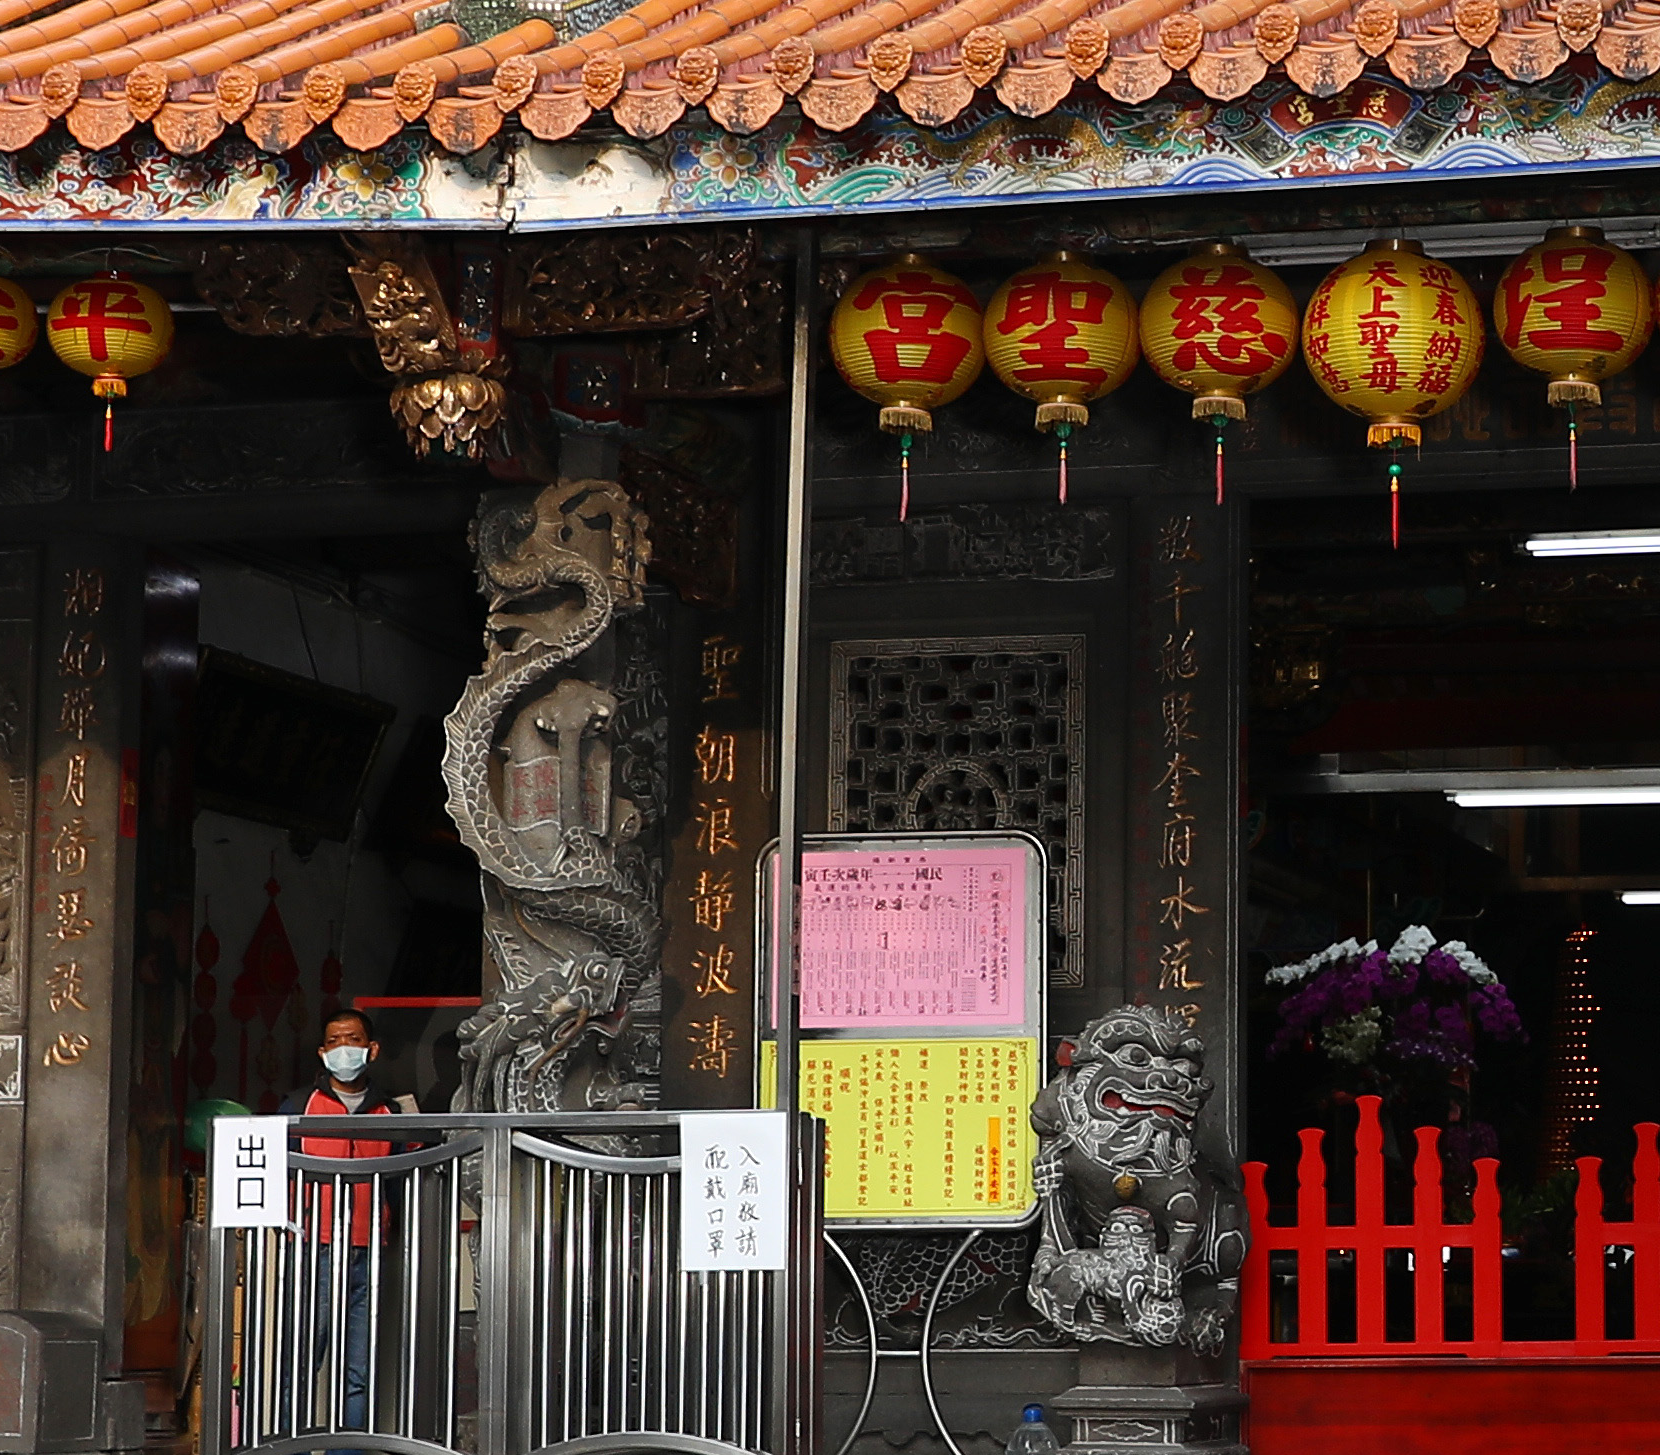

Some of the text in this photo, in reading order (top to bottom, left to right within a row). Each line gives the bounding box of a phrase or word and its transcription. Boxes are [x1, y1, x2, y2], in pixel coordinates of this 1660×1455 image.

[851, 270, 983, 386] 宮
[996, 267, 1116, 386] 聖
[1168, 267, 1288, 377] 慈
[1357, 260, 1409, 395] 天上聖母
[1413, 263, 1467, 395] 迎春納福
[1501, 248, 1623, 351] 埕
[236, 1133, 268, 1211] 出口
